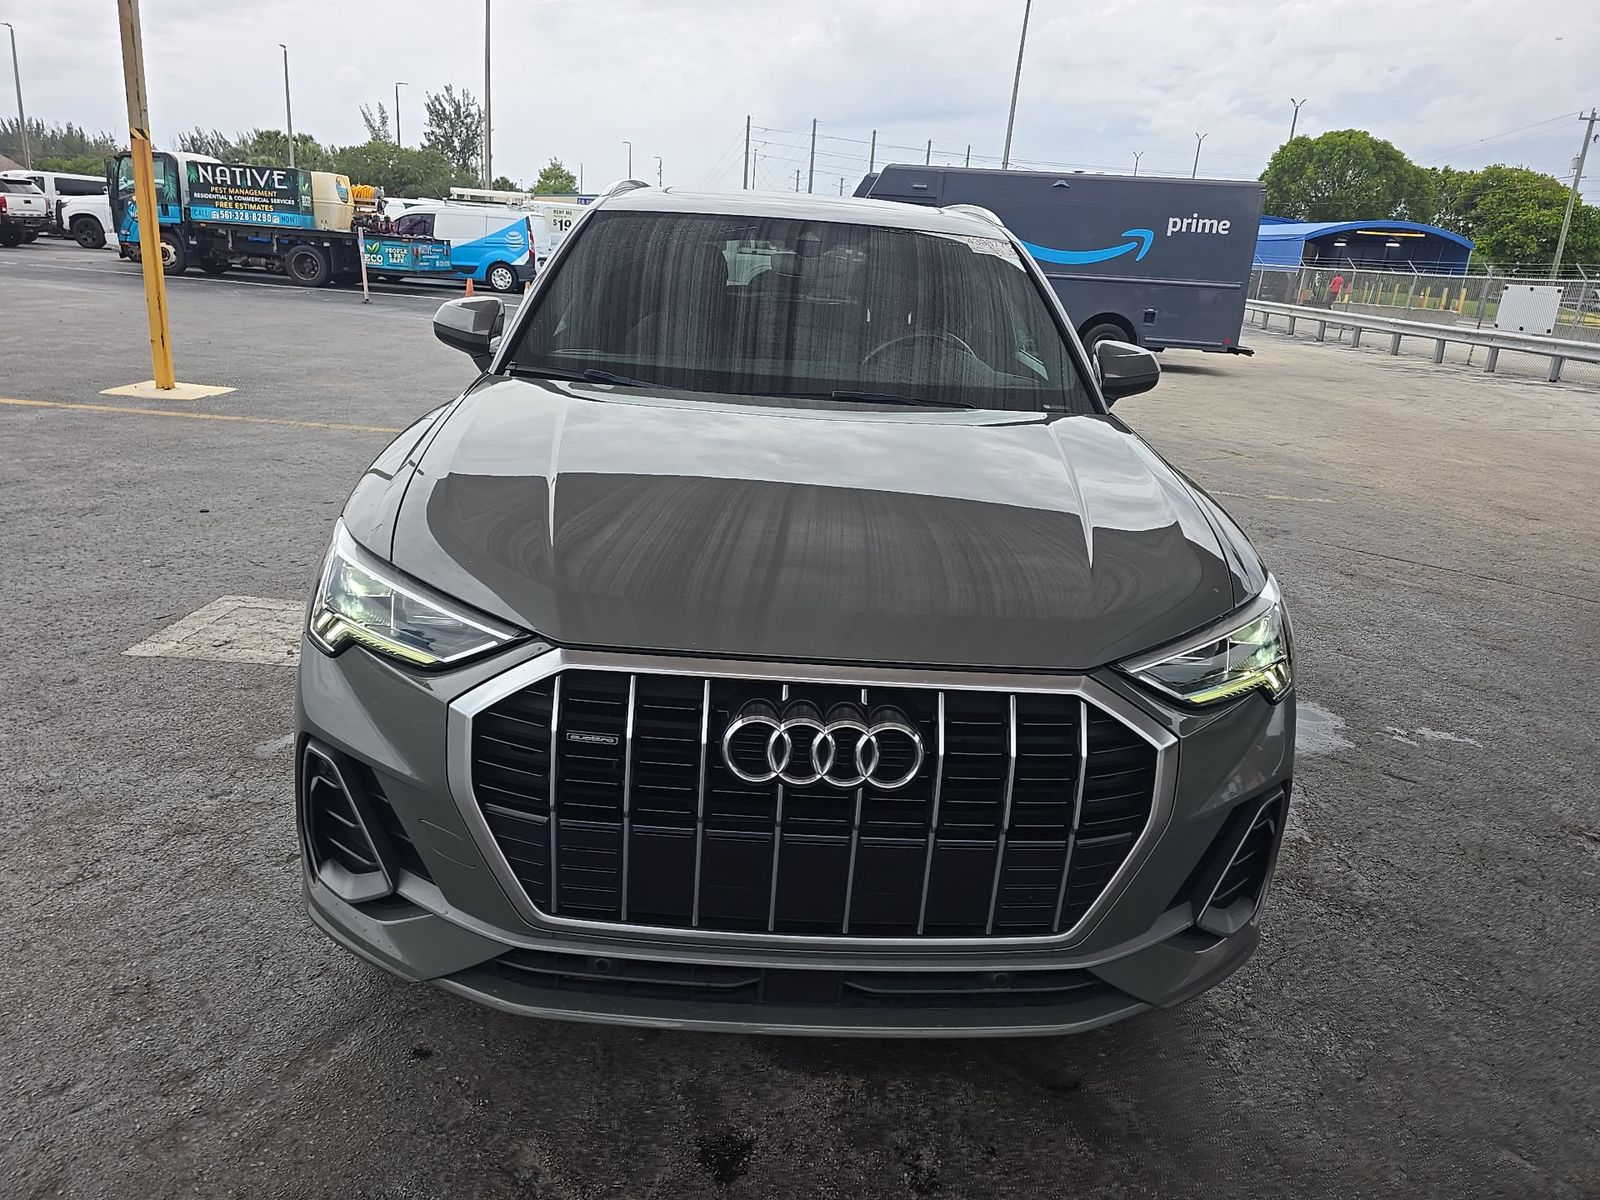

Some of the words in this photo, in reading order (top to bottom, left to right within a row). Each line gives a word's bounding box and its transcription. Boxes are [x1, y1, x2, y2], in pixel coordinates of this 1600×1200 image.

[197, 164, 288, 189] NATIVE
[210, 186, 228, 194] PEST
[228, 187, 278, 197] MANAGEMENT
[193, 192, 228, 200] RESIDENTIAL
[234, 195, 270, 204] COMMERCIAL
[270, 198, 295, 206] SERVICES
[215, 201, 233, 209] FREE
[235, 202, 274, 212] ESTIMATES
[1166, 213, 1231, 237] prime
[364, 254, 384, 263] ECO
